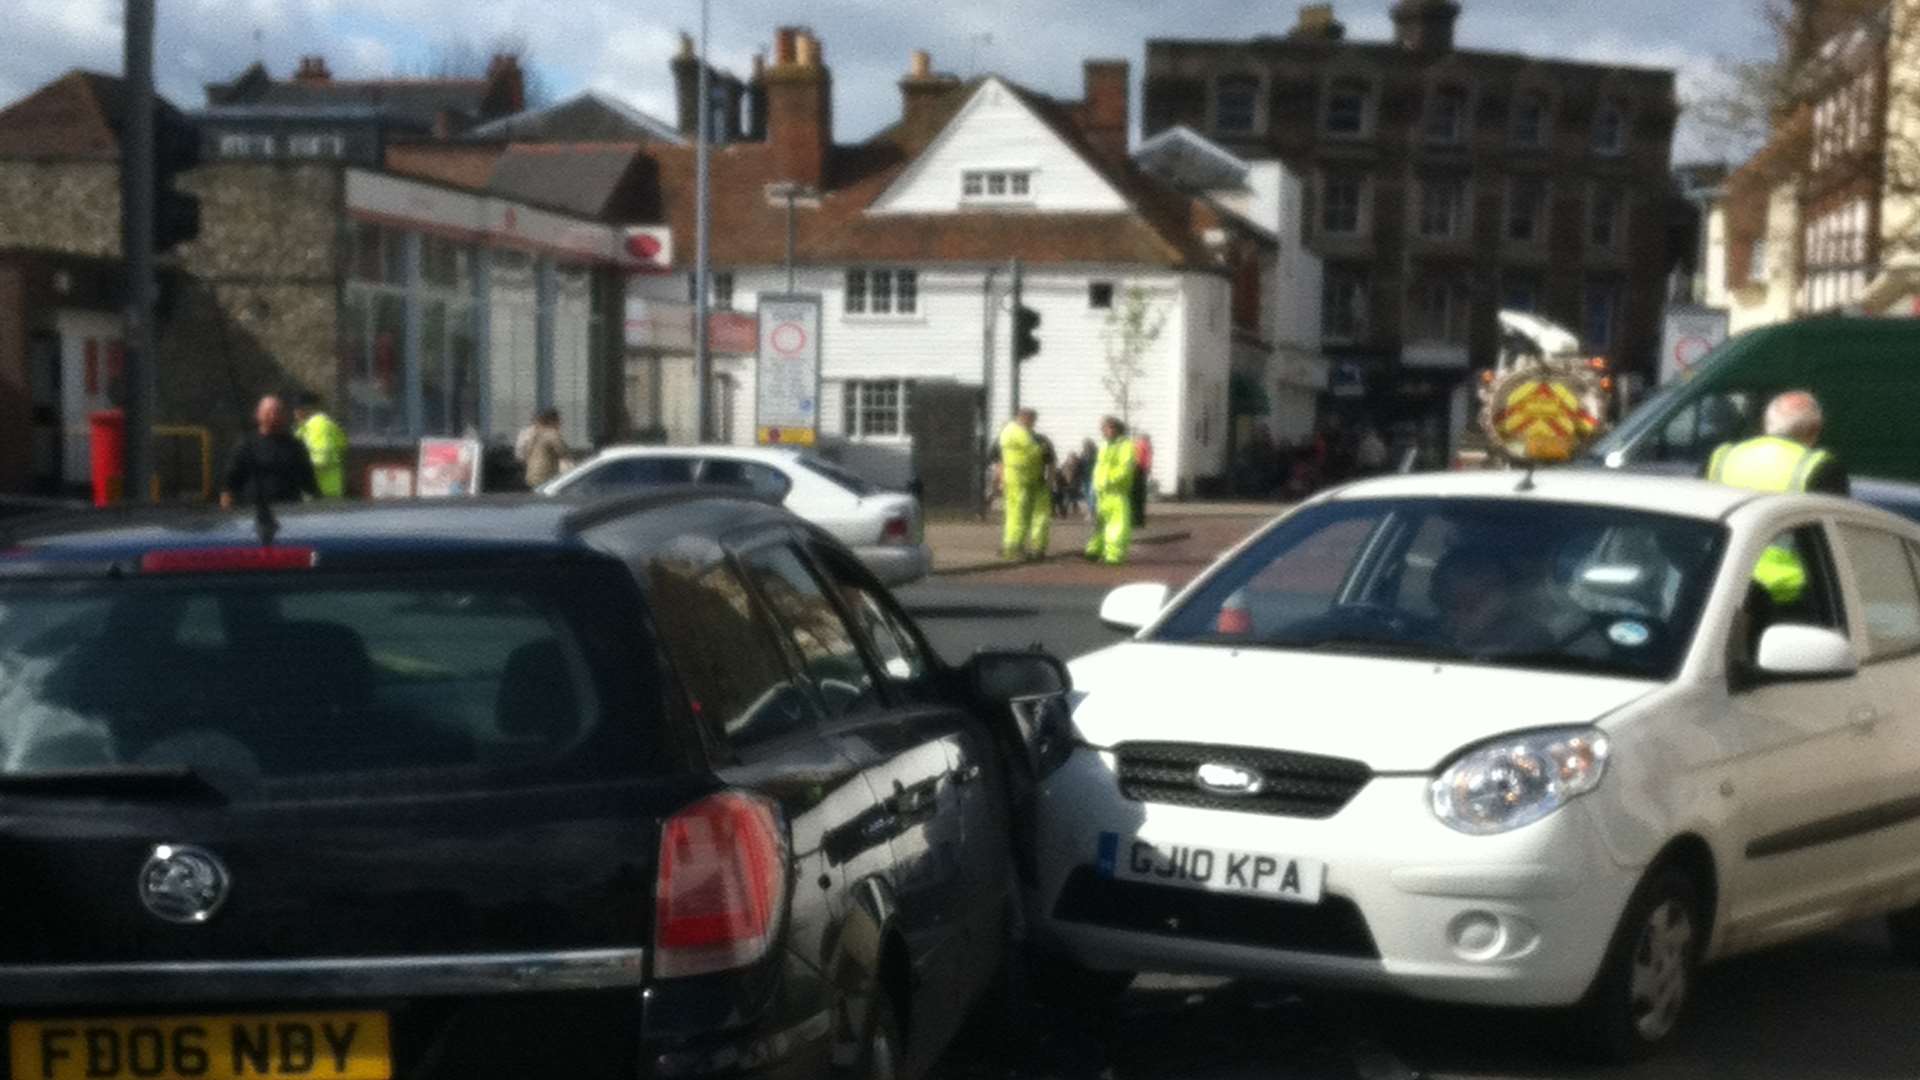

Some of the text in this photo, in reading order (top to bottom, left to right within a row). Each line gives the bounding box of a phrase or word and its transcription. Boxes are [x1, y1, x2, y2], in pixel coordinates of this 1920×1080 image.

[1130, 841, 1301, 894] GJ10 KPA
[41, 1022, 357, 1079] FD06 NBY
